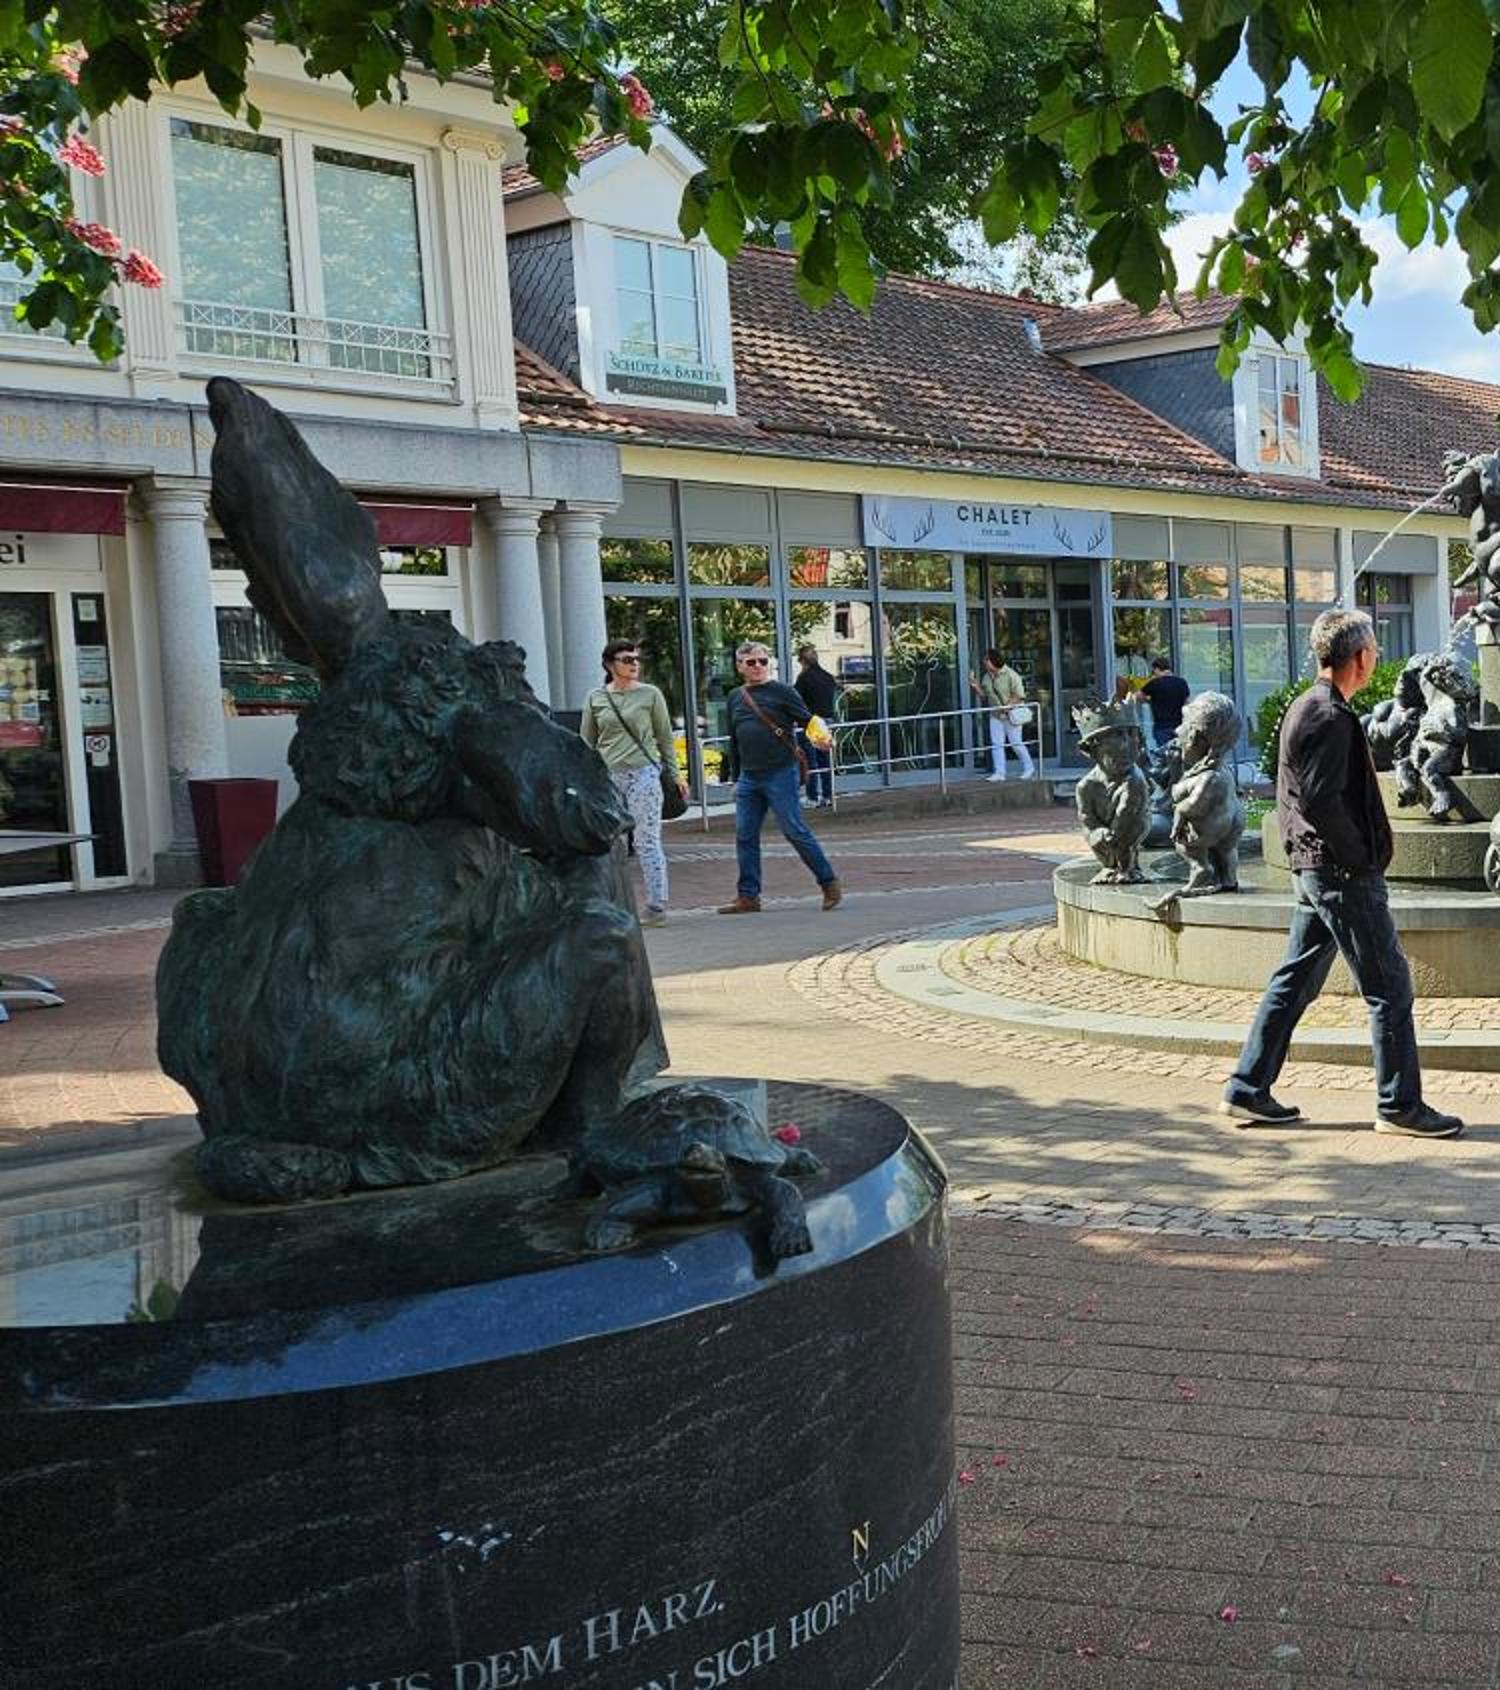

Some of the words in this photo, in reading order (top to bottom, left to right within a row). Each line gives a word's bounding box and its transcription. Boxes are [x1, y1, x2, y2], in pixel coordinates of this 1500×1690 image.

[957, 505, 1032, 527] CHALET
[851, 1520, 871, 1561] N
[452, 1634, 564, 1690] DEM
[582, 1578, 726, 1661] HARZ.
[693, 1625, 778, 1690] SICH
